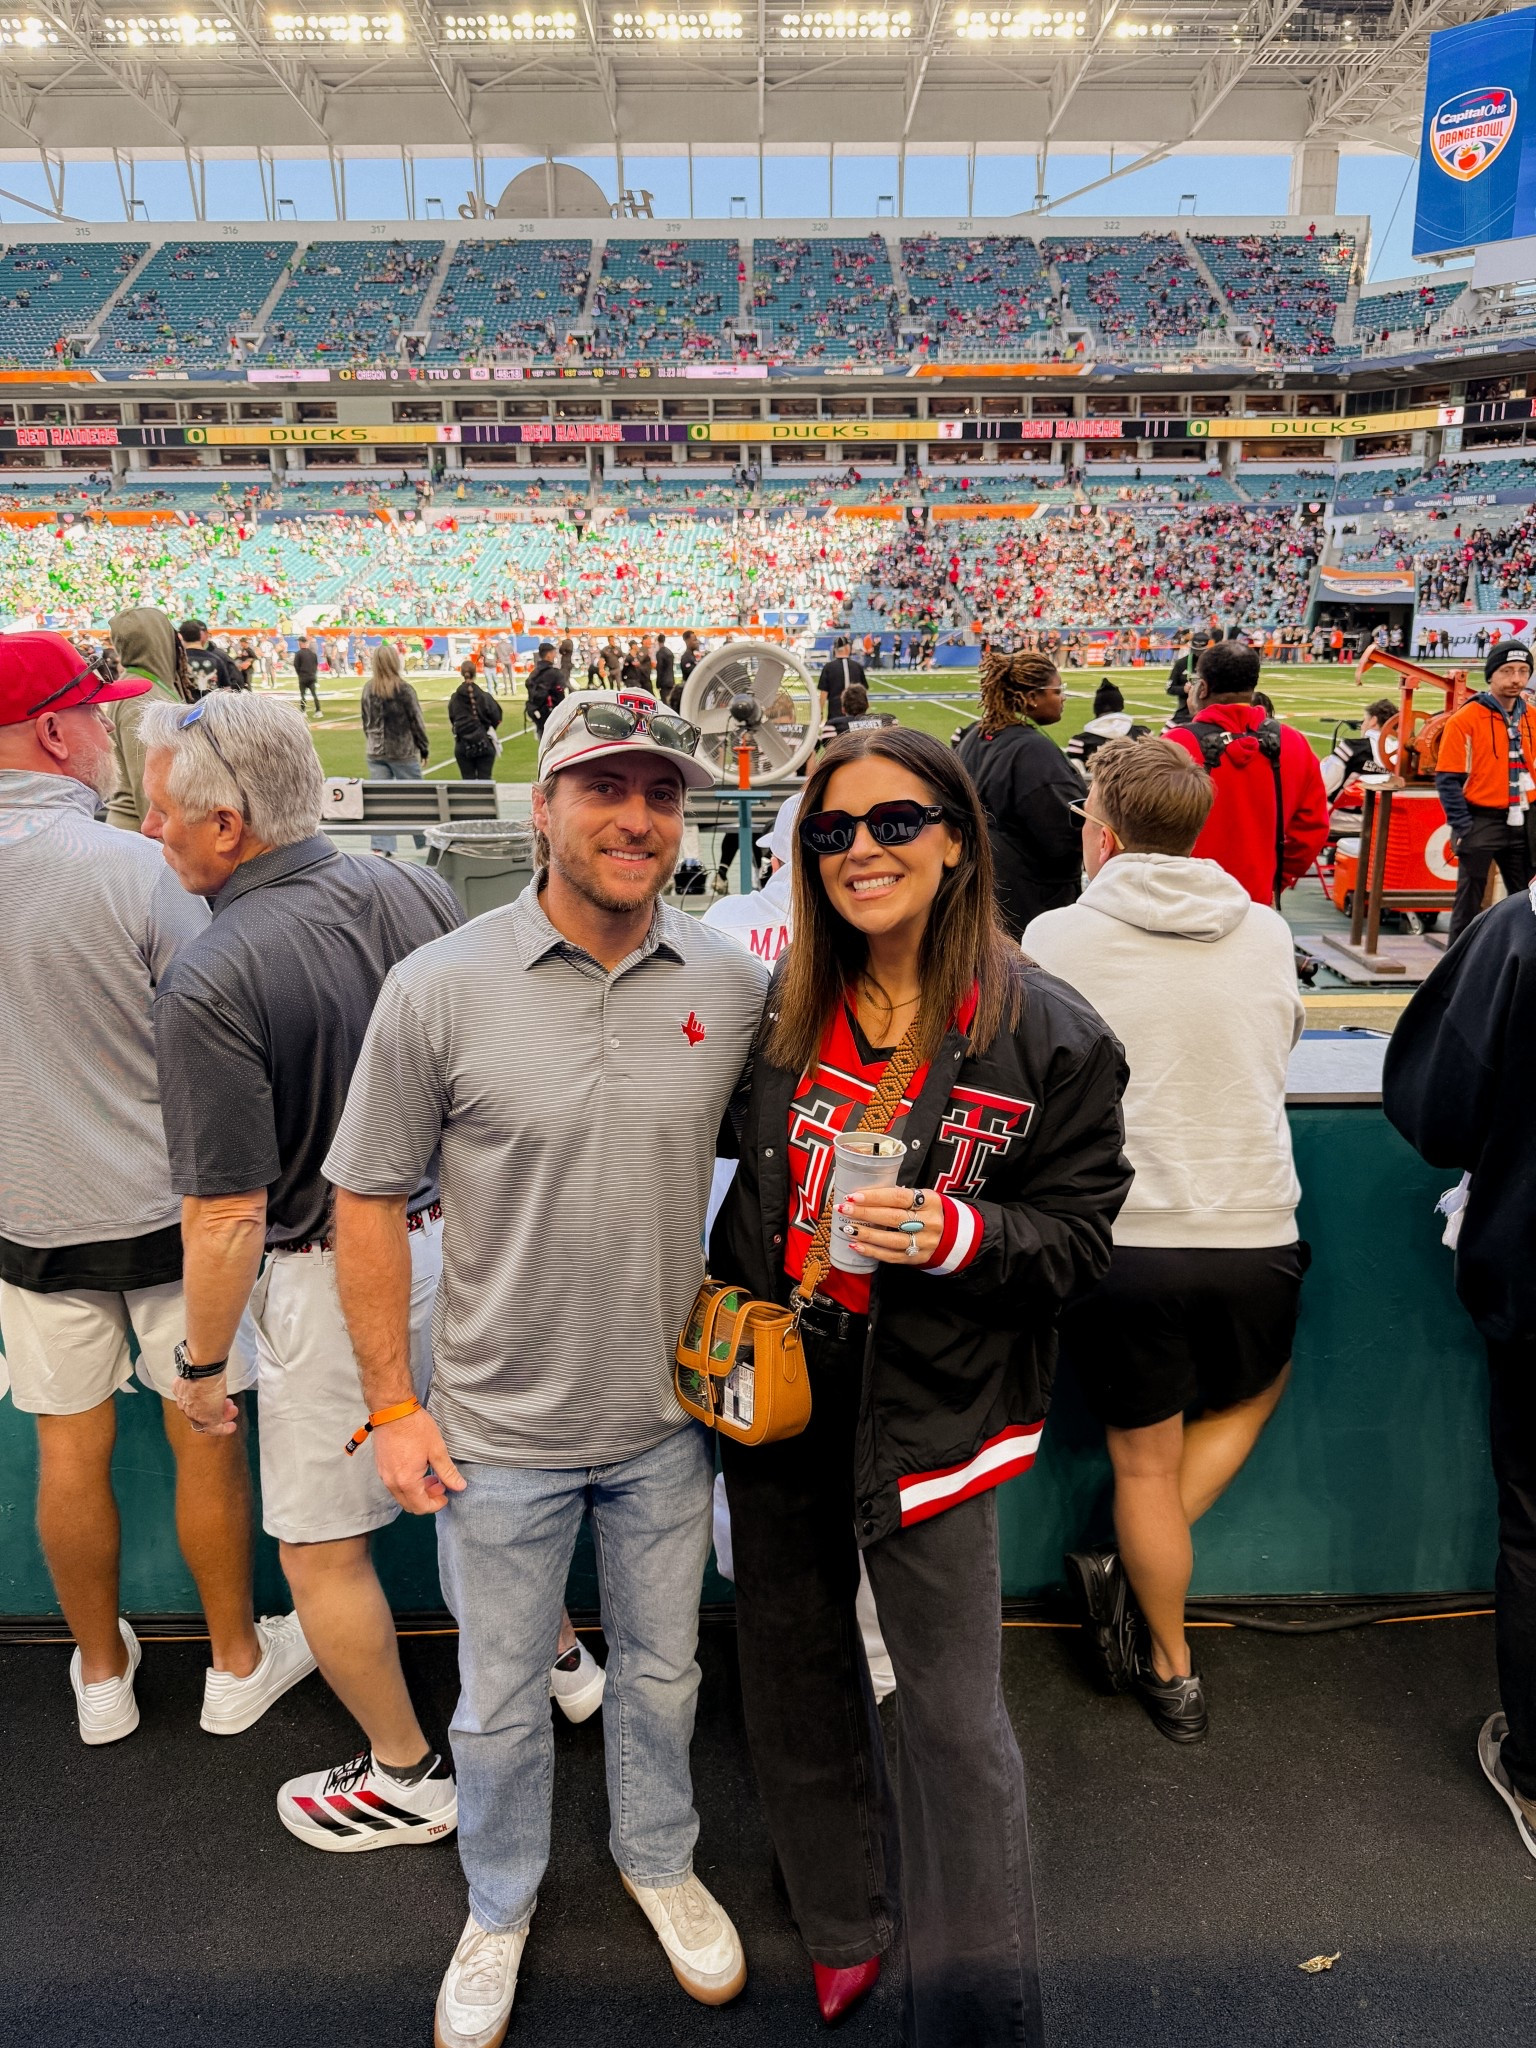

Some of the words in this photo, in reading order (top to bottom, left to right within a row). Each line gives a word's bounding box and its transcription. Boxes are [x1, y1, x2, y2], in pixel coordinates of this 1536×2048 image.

[1439, 127, 1476, 150] ORANGE
[1476, 120, 1504, 138] BOWL
[222, 226, 239, 235] 316
[370, 225, 386, 234] 317
[519, 224, 535, 233] 318
[1103, 221, 1121, 230] 322
[1269, 220, 1287, 230] 323
[75, 227, 91, 236] 315
[1411, 275, 1430, 287] 324
[427, 369, 449, 380] TTU
[772, 425, 869, 439] DUCKS
[1021, 420, 1052, 438] RED
[1055, 420, 1123, 438] RAIDERS
[1271, 419, 1368, 433] DUCKS
[16, 428, 48, 446] RED
[50, 428, 119, 446] RAIDERS
[269, 428, 368, 441] DUCKS
[521, 424, 552, 442] RED
[555, 424, 622, 442] RAIDERS
[427, 1823, 448, 1836] TECH
